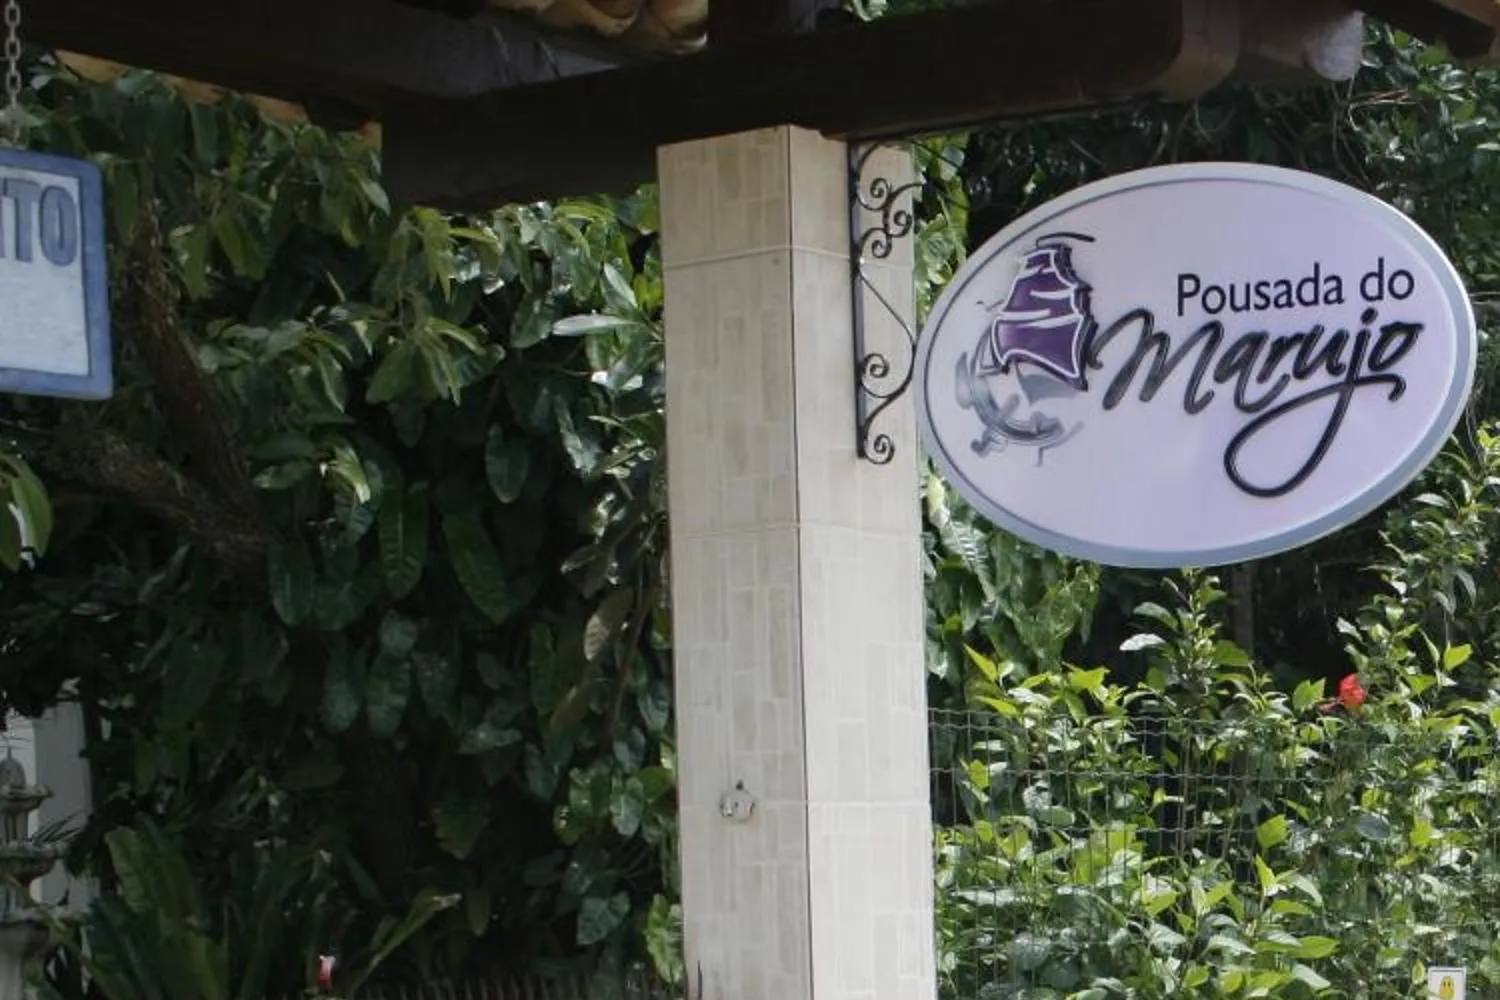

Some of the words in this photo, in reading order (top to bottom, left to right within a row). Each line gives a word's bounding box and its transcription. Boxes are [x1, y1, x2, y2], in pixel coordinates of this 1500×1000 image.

[0, 177, 78, 266] TO
[1178, 261, 1344, 316] Pousada
[1360, 257, 1415, 301] do
[1094, 308, 1423, 498] Marujo
